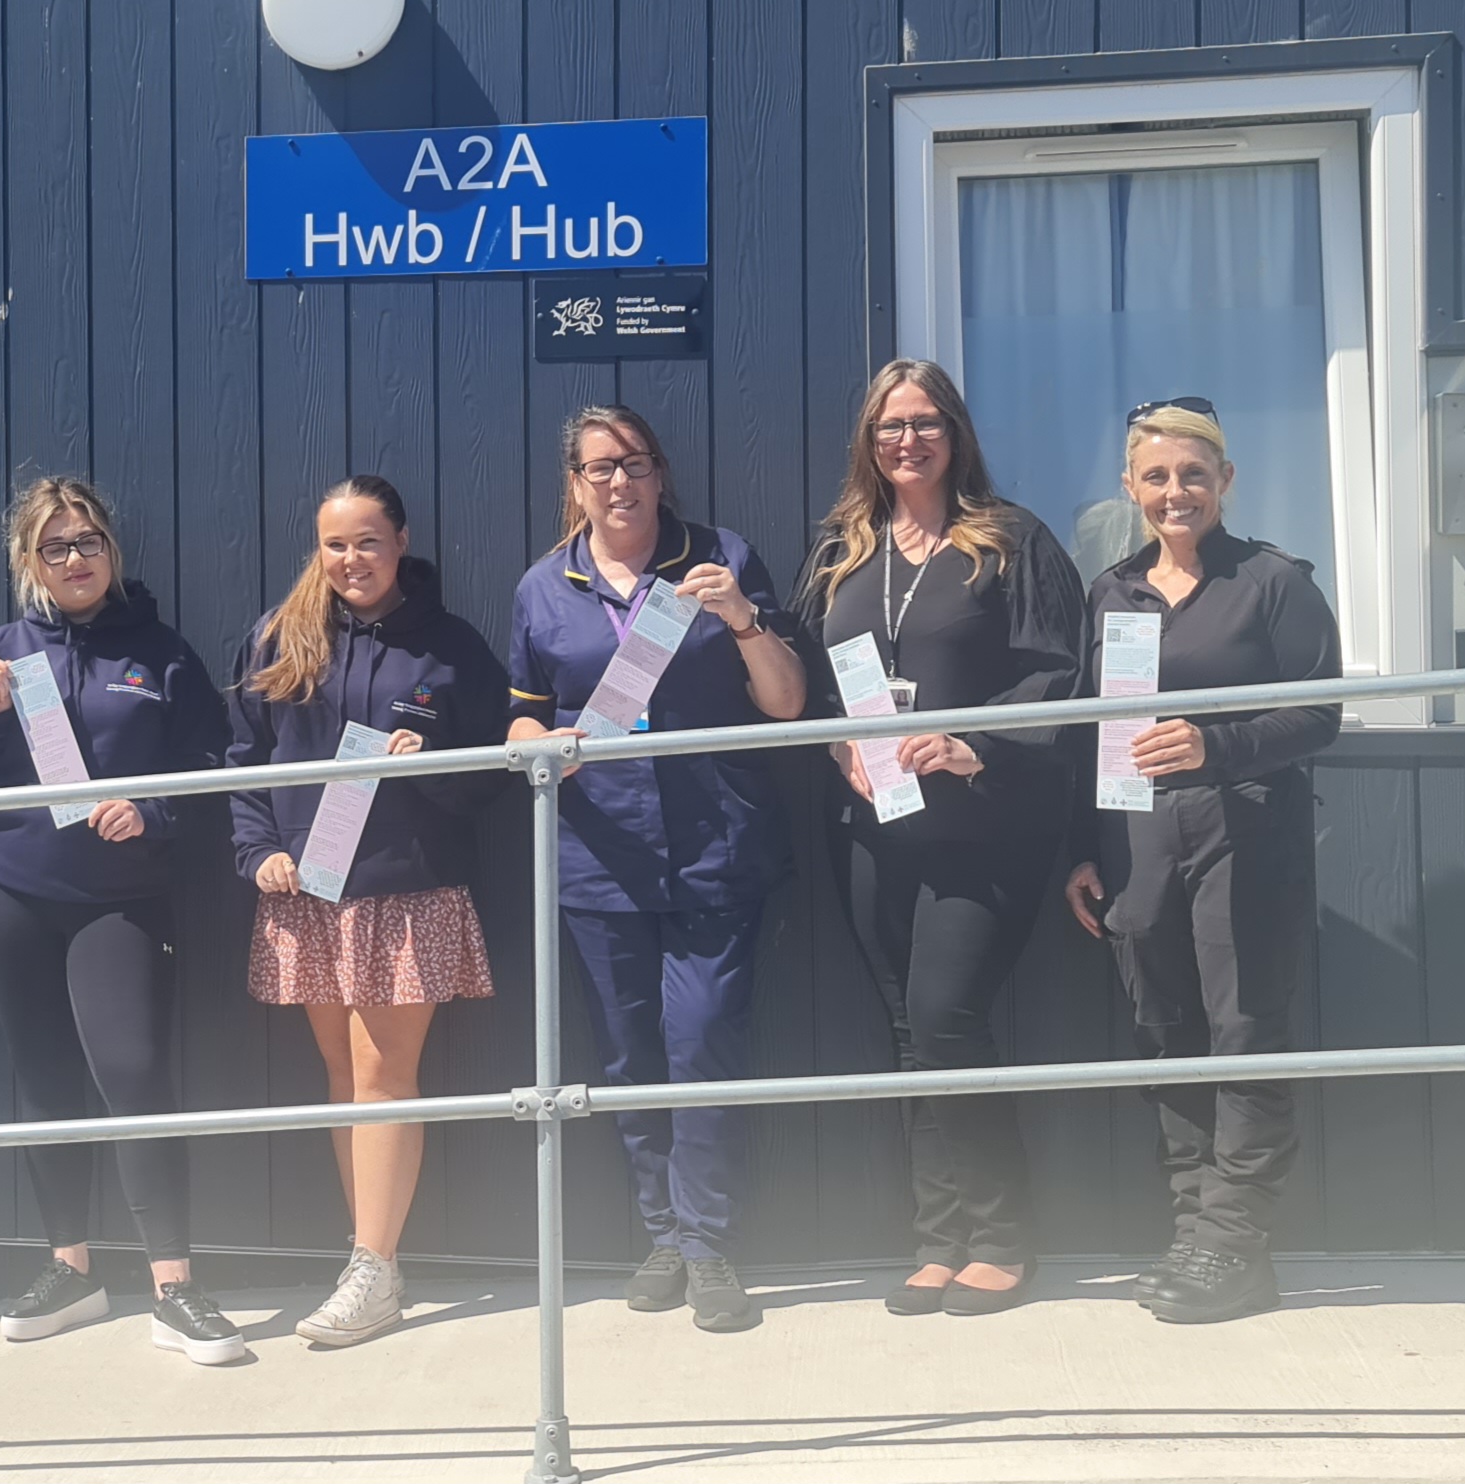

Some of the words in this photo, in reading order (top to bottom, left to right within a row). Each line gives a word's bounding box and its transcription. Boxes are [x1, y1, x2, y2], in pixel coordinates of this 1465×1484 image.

[403, 133, 548, 193] A2A
[304, 209, 444, 268] Hwb
[465, 206, 487, 263] /
[511, 201, 644, 261] Hub
[642, 296, 656, 305] gan
[616, 304, 660, 315] Lywodraeth
[661, 304, 686, 314] Cymru
[616, 317, 640, 325] Funded
[641, 317, 649, 326] by
[616, 326, 639, 335] Welsh
[639, 325, 686, 334] Government
